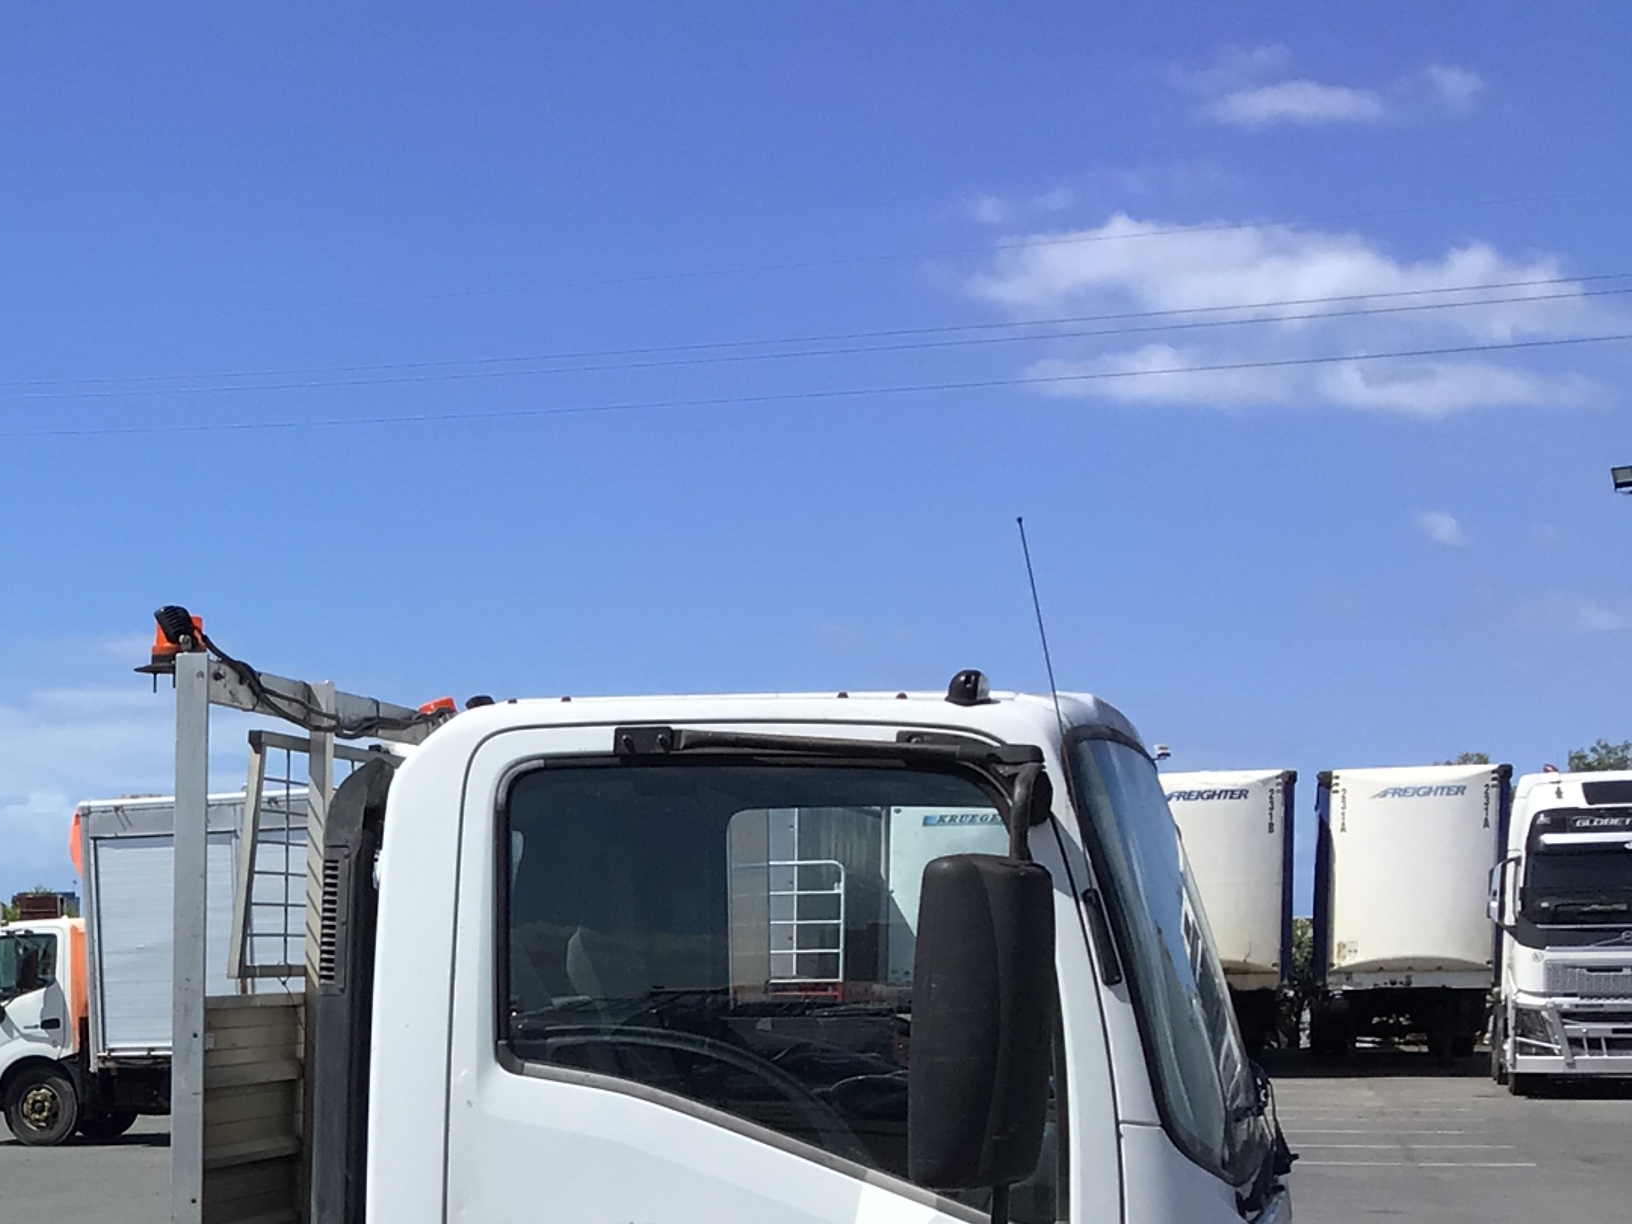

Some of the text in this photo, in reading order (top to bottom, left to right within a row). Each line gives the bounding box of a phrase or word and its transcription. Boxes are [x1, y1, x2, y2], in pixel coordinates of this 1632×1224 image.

[1168, 788, 1250, 801] FREIGHTER
[1373, 785, 1467, 799] FREIGHTER
[937, 813, 1003, 824] KRUEGE
